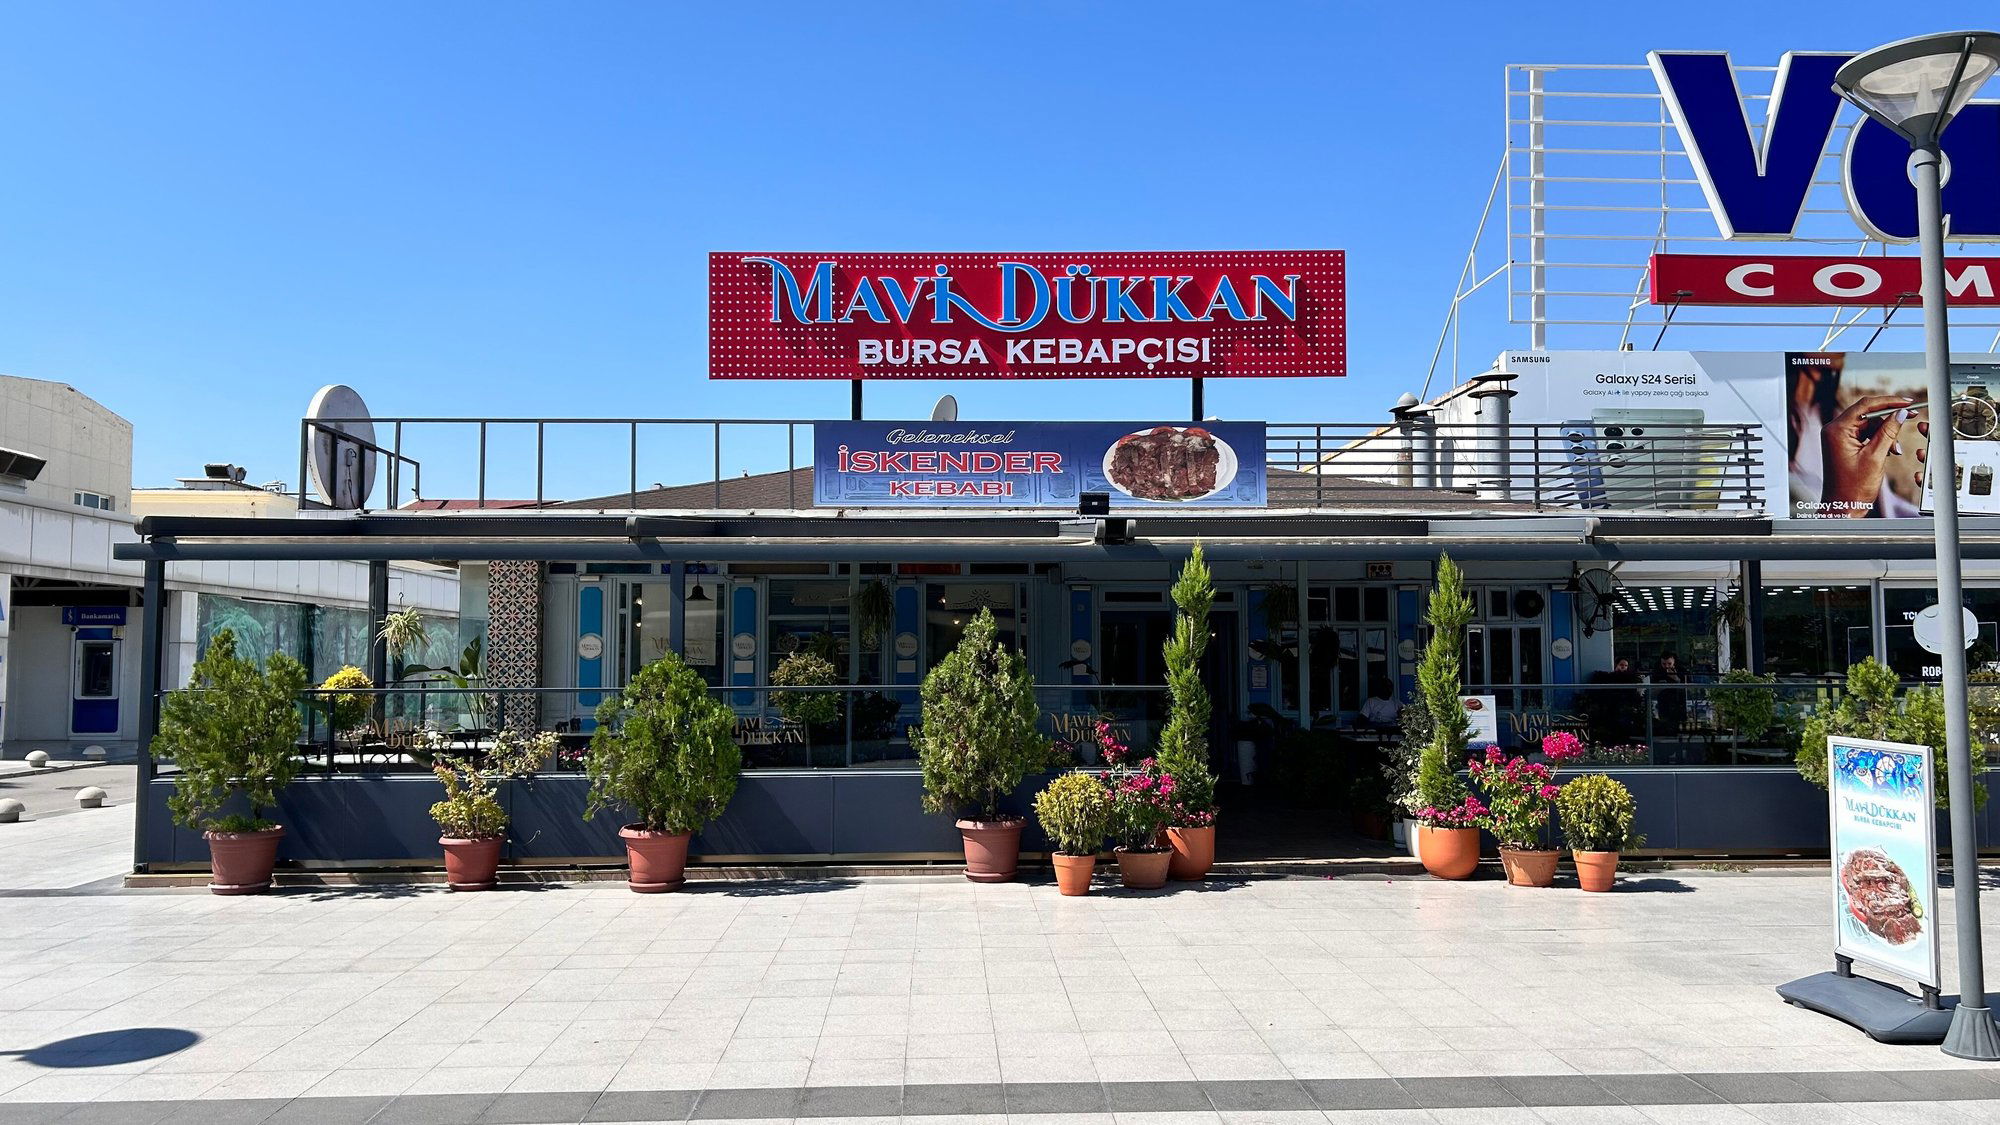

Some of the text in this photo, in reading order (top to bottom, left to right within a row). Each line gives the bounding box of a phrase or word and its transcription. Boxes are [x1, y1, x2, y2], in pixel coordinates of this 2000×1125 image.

[995, 261, 1302, 332] DÜKKAN
[858, 338, 1210, 370] BURSA KEBAPÇISI
[1791, 357, 1831, 365] SAMSUNG
[1595, 373, 1696, 387] Galaxy S24 Serisi
[1582, 388, 1606, 397] Galaxy
[1631, 389, 1651, 398] yapay
[1652, 388, 1669, 396] zeka
[886, 428, 1016, 445] Geleneksel
[838, 444, 1063, 474] İSKENDER
[889, 480, 1014, 497] KEBABI
[1796, 501, 1874, 511] Galaxy S24 Ultra
[1921, 666, 1944, 677] ROB
